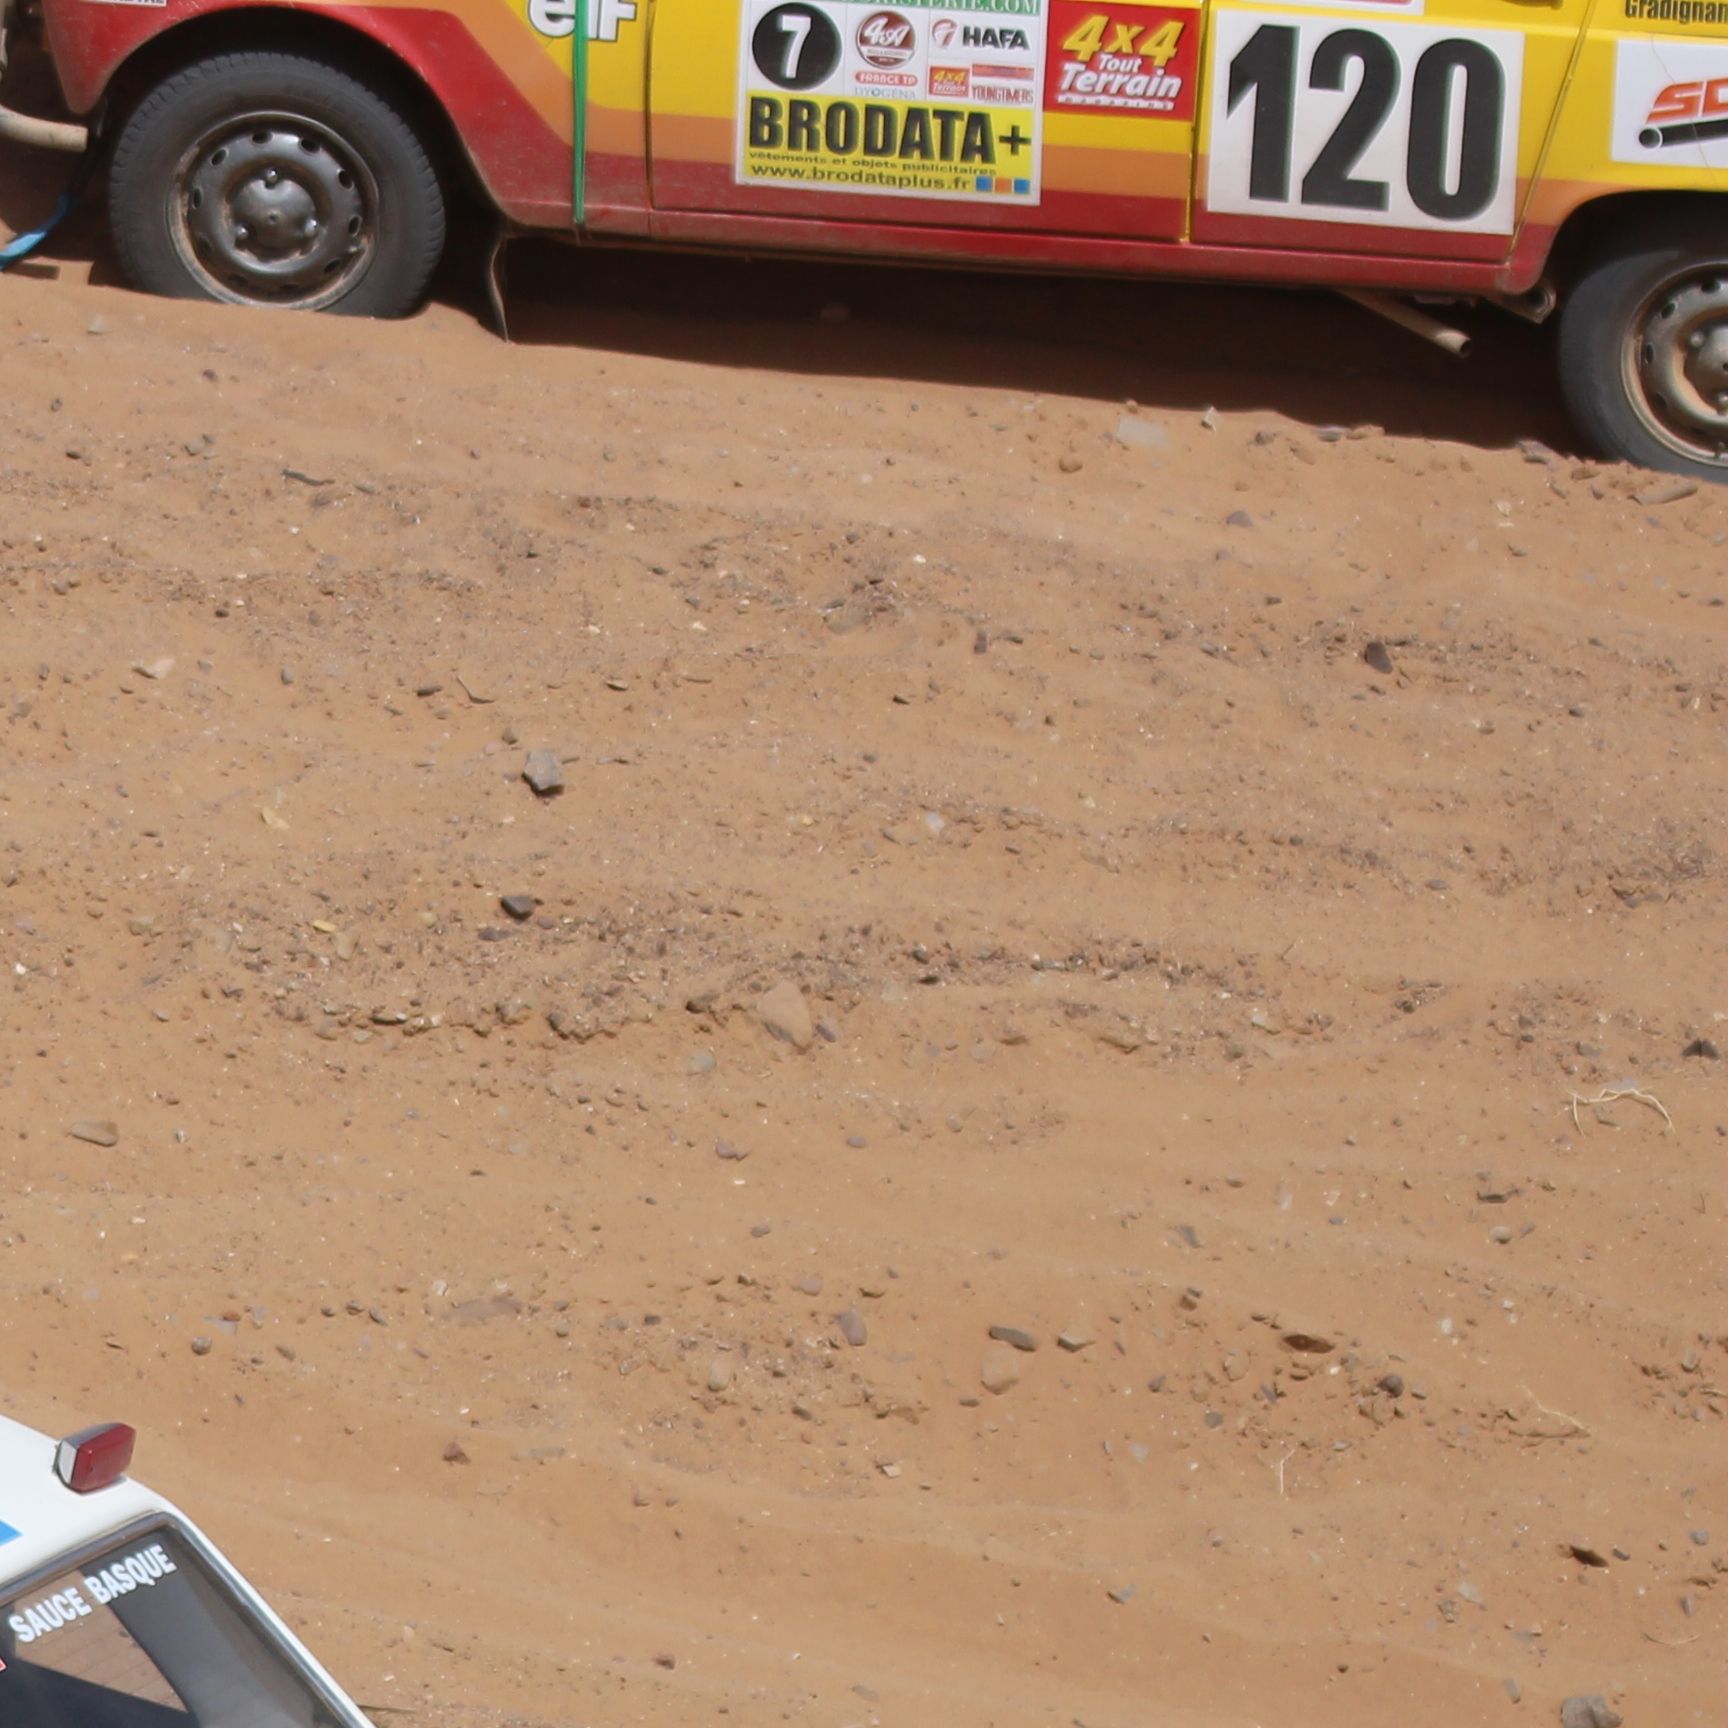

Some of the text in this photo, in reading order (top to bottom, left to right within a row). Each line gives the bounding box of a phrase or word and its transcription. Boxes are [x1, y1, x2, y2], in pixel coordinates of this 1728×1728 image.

[779, 15, 812, 79] 7
[962, 26, 1030, 50] HAFA
[1061, 14, 1185, 68] 4x4
[859, 73, 899, 86] FRANCE
[1059, 62, 1182, 98] Terrain
[1098, 53, 1142, 74] Tout
[749, 96, 1032, 164] BRODATA+
[1226, 23, 1507, 221] 120
[751, 162, 970, 191] www.brodataplus.fr
[832, 156, 847, 166] et
[852, 159, 898, 171] objets
[902, 162, 997, 176] publicitaires
[8, 1586, 93, 1646] SAUCE
[82, 1541, 178, 1606] BASQUE
